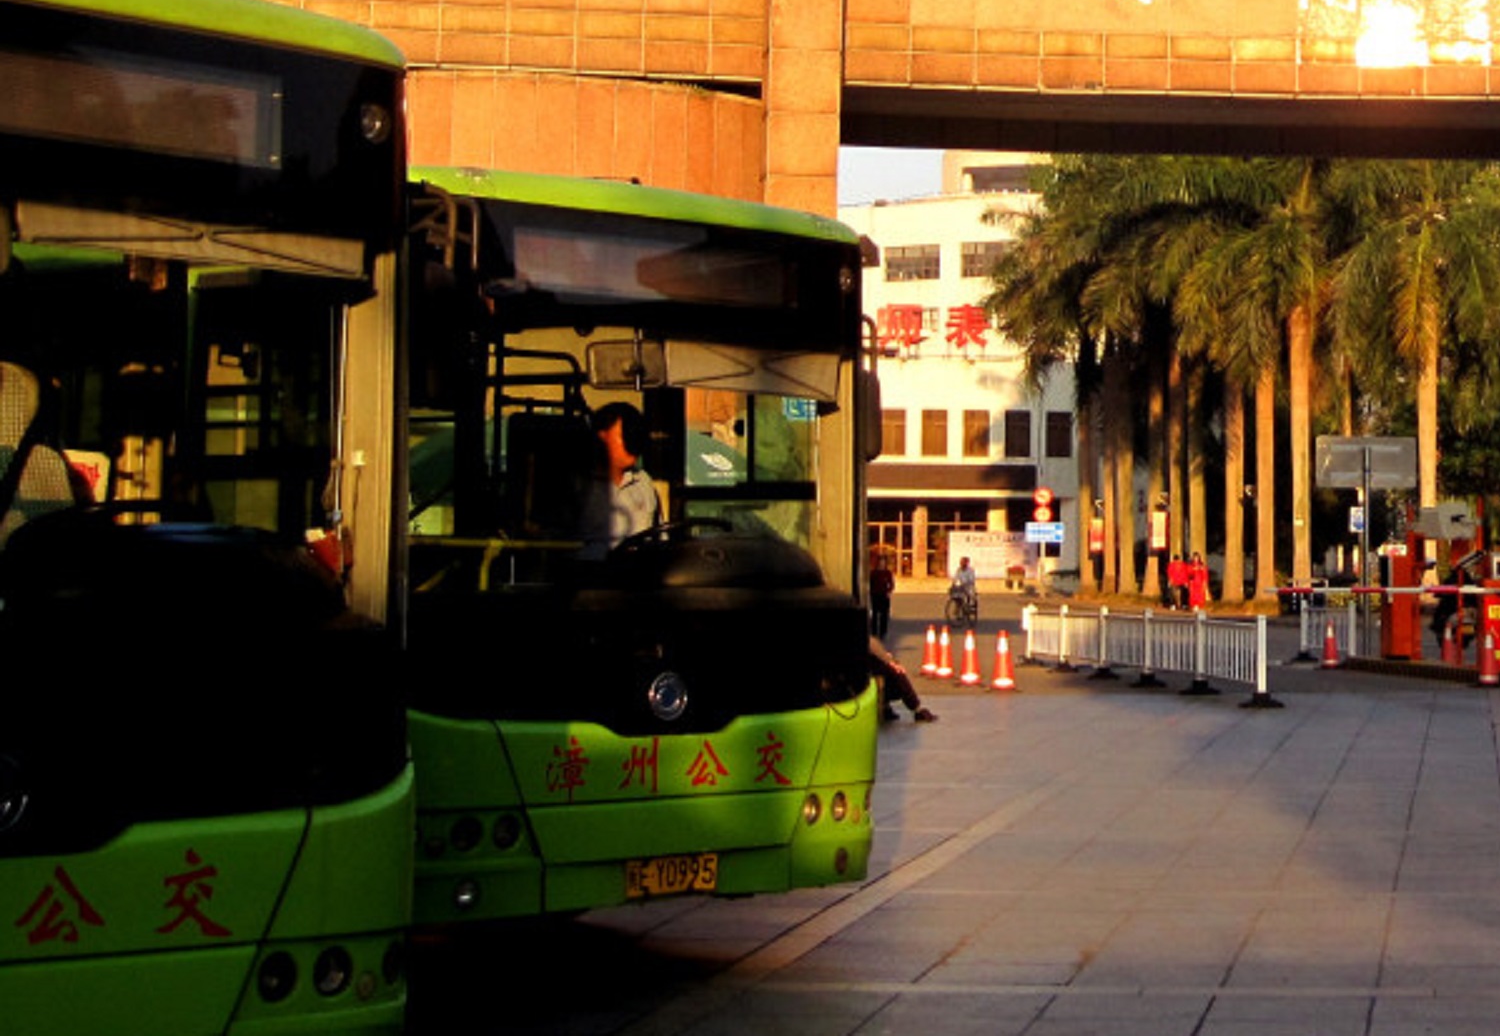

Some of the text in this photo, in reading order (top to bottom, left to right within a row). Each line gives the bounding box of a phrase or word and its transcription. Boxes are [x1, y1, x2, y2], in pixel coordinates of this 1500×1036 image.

[546, 731, 792, 801] 漳州公交
[15, 848, 233, 944] 公交
